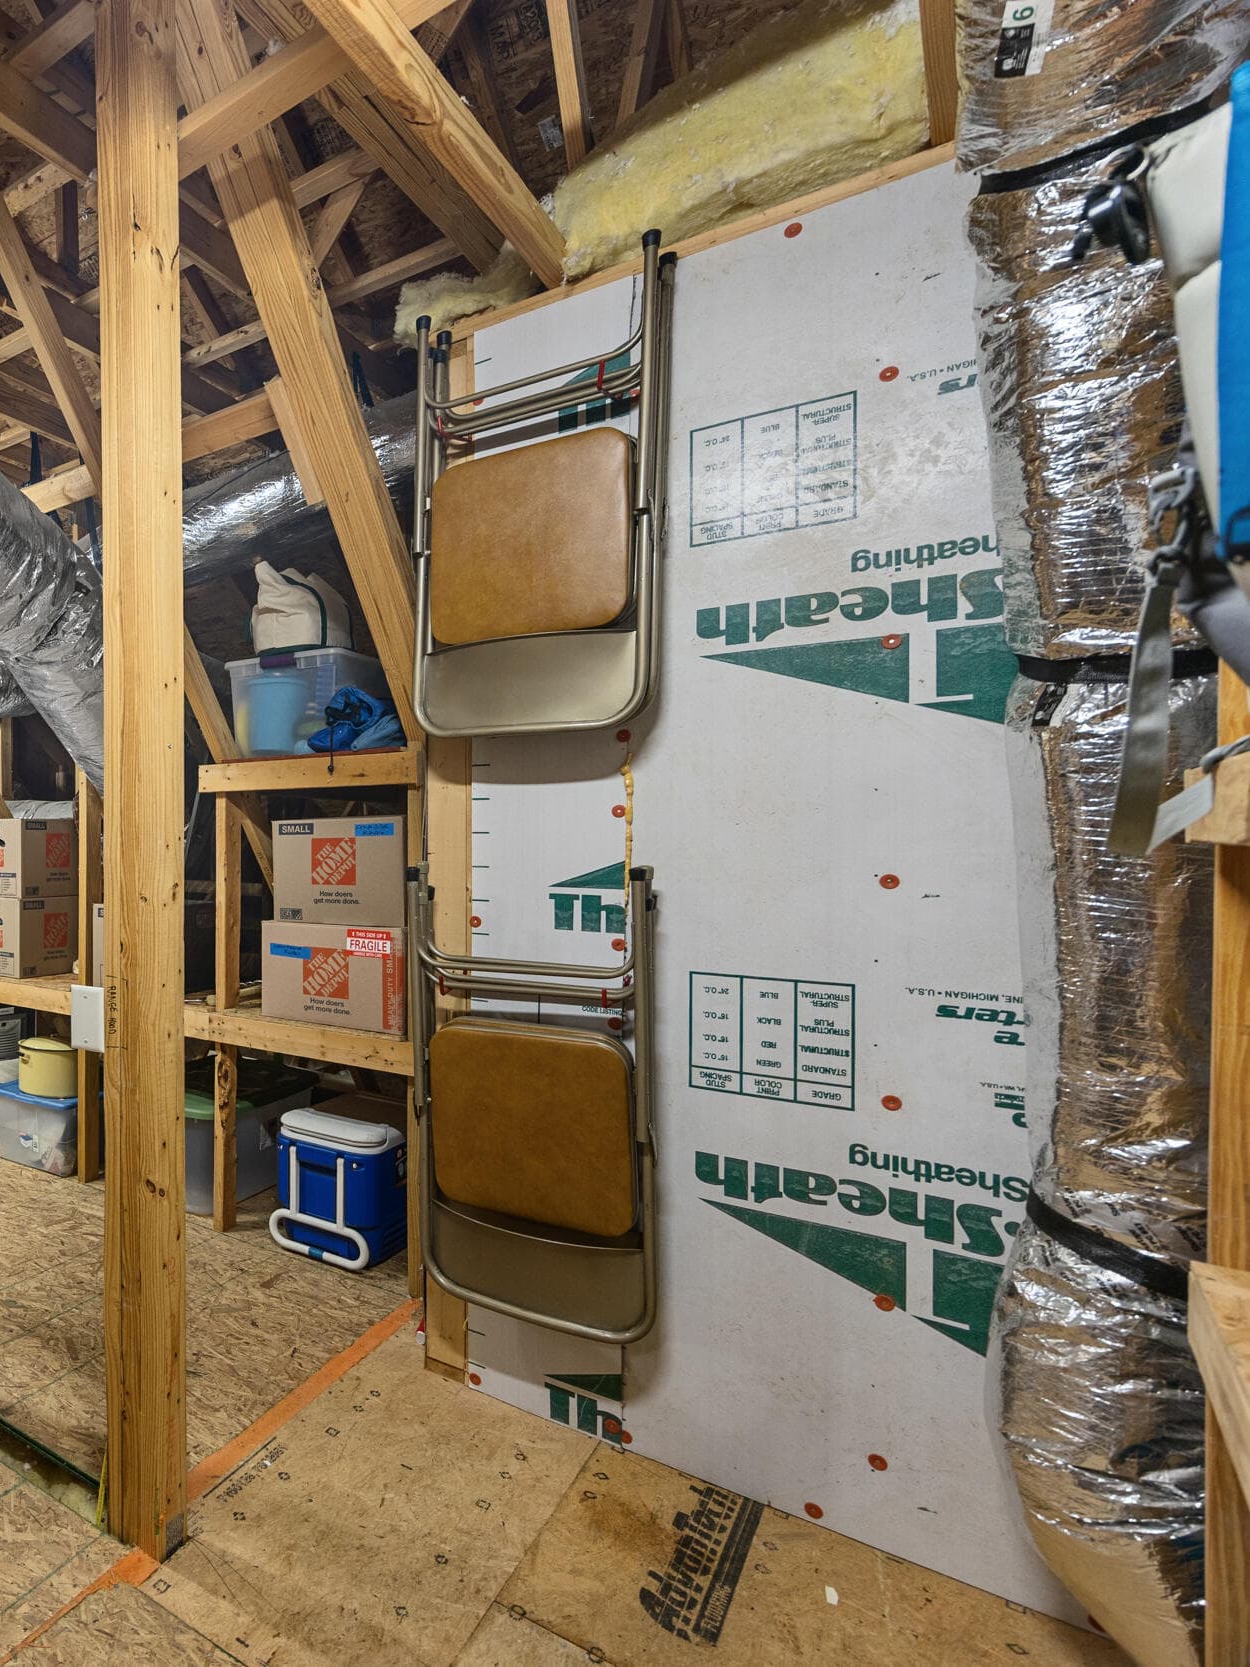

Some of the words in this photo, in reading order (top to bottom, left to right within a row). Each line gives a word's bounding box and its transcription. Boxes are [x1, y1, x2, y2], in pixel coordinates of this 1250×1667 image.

[907, 369, 937, 382] U.S.A.
[801, 403, 852, 421] STRUCTURAL
[760, 423, 780, 434] BLUE
[851, 534, 1001, 573] heathing
[695, 566, 1005, 647] Sheath
[281, 825, 311, 833] SMALL
[316, 842, 335, 861] THE
[312, 837, 356, 885] HOME
[328, 856, 356, 885] DEPOT
[334, 890, 353, 898] doers
[313, 897, 324, 905] get
[549, 893, 625, 934] Th
[350, 939, 387, 953] FRAGILE
[308, 951, 327, 972] THE
[303, 949, 349, 996] HOME
[320, 967, 349, 997] DEPOT
[703, 986, 717, 994] O.C.
[759, 991, 779, 1000] BLUE
[905, 987, 935, 996] U.S.A.
[799, 991, 850, 1002] STRUCTURAL
[945, 990, 999, 1002] MICHIGAN
[303, 1004, 315, 1012] get
[309, 997, 324, 1005] How
[325, 999, 344, 1008] doers
[810, 1000, 839, 1009] SUPER-
[581, 1006, 599, 1014] CODE
[600, 1007, 623, 1017] LISTING
[935, 1004, 1025, 1027] ters
[756, 1017, 782, 1026] BLACK
[813, 1018, 835, 1027] PLUS
[799, 1024, 850, 1036] STRUCTURAL
[703, 1033, 717, 1042] O.C.
[761, 1040, 777, 1049] RED
[703, 1052, 717, 1060] O.C.
[798, 1044, 850, 1058] STRUCTURAL
[756, 1058, 782, 1068] GREEN
[801, 1064, 847, 1077] STANDARD
[699, 1071, 733, 1082] SPACING
[705, 1079, 726, 1088] STUD
[754, 1078, 783, 1089] COLOR
[756, 1087, 780, 1096] PRINT
[811, 1089, 842, 1101] GRADE
[848, 1143, 1031, 1203] Sheathing
[695, 1150, 1006, 1258] Sheath
[544, 1381, 622, 1447] Th
